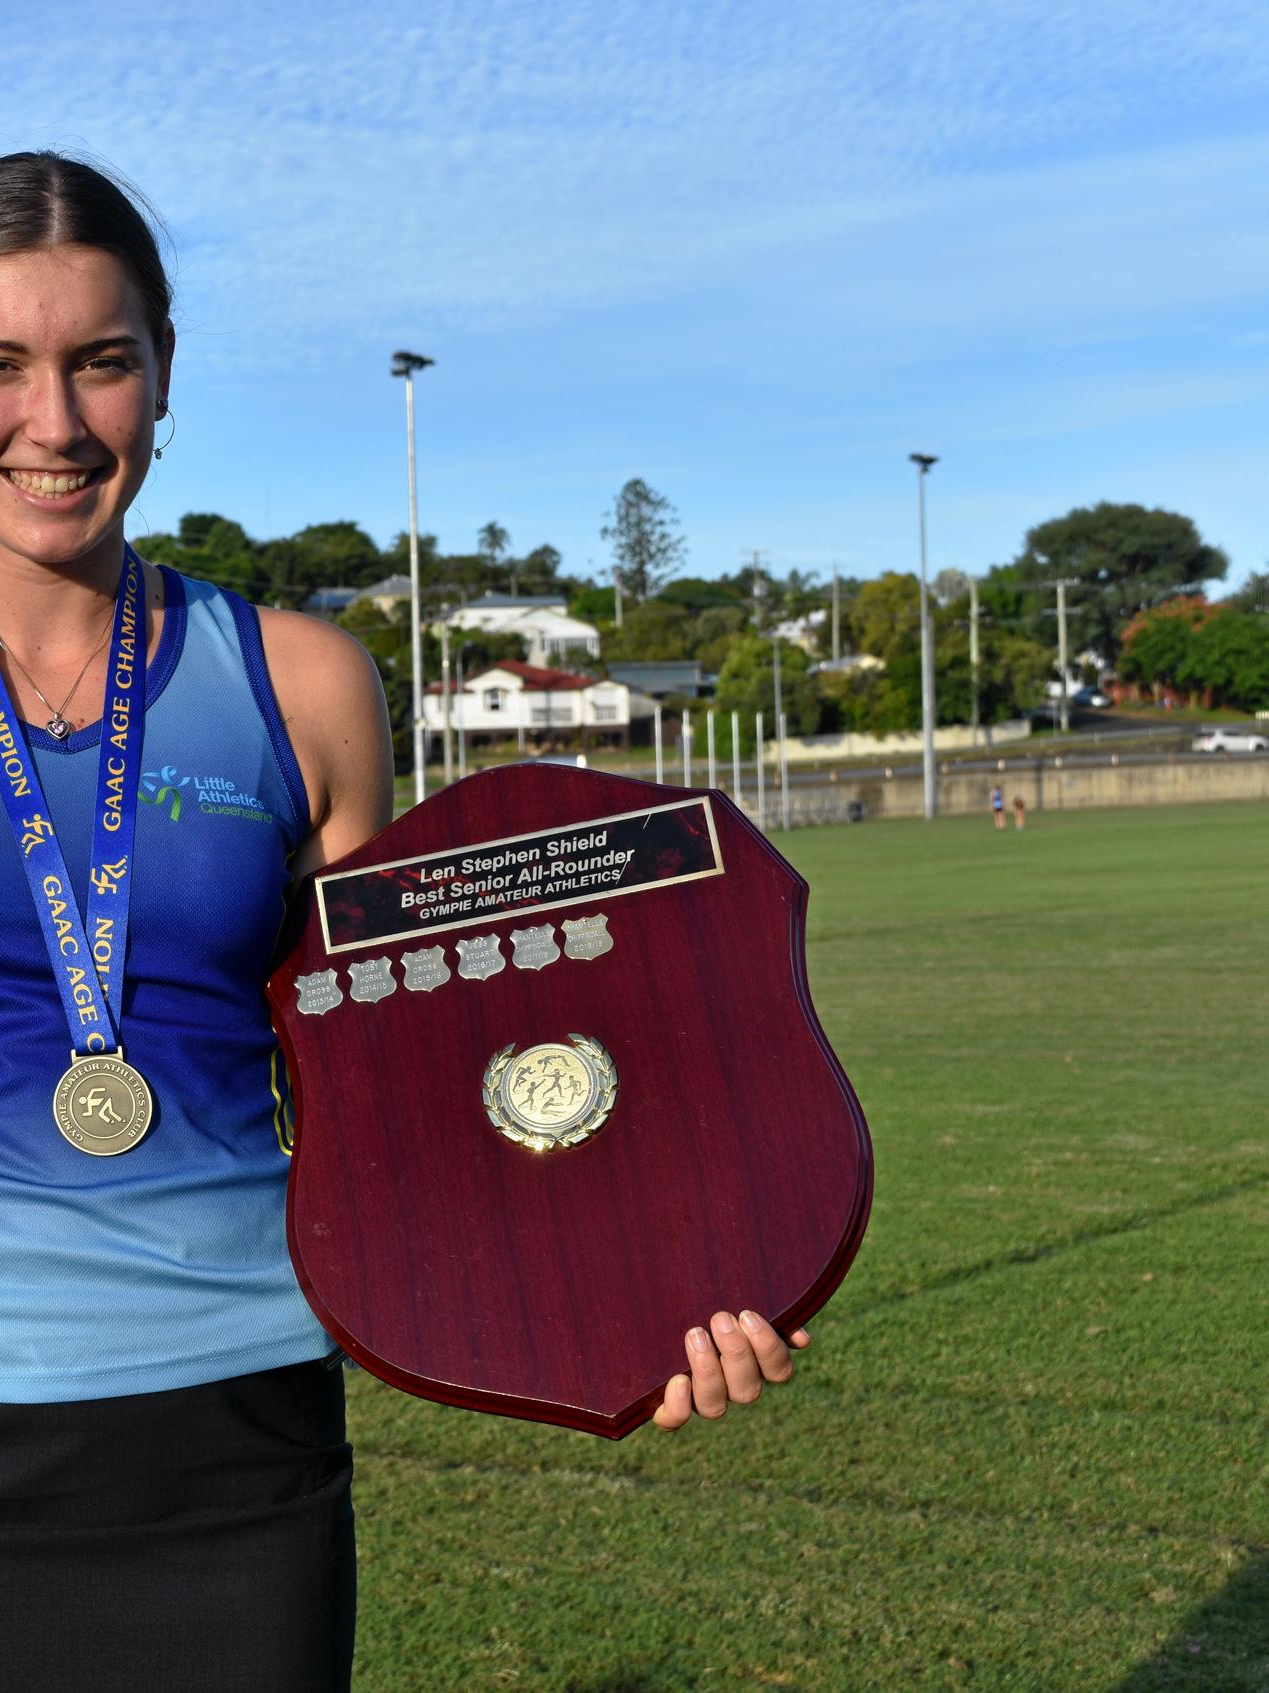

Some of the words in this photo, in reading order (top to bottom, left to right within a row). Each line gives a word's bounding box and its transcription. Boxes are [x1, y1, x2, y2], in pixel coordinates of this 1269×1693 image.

[115, 556, 138, 690] CHAMPION
[110, 697, 130, 750] AGE
[102, 758, 126, 831] GAAC
[194, 776, 235, 791] Little
[198, 790, 265, 810] Athletics
[200, 802, 273, 824] Queensland
[420, 865, 456, 884] Len
[461, 847, 541, 876] Stephen
[546, 831, 608, 857] Shield
[401, 886, 445, 909] Best
[450, 872, 515, 899] Senior
[517, 847, 635, 885] All-Rounder
[419, 897, 473, 919] GYMPIE
[475, 885, 542, 908] AMATEUR
[544, 868, 621, 895] ATHLETICS
[43, 875, 78, 956] GAAC
[66, 966, 98, 1025] AGE
[415, 953, 433, 963] ADAM
[466, 949, 493, 961] STUART
[359, 973, 383, 983] HORNE
[413, 963, 437, 974] CROSS
[467, 959, 496, 971] 2016/17
[307, 976, 328, 986] ADAM
[307, 986, 331, 997] CROSS
[60, 1063, 100, 1100] AMATEUR
[103, 1063, 146, 1107] ATHLETICS
[60, 1103, 83, 1142] GYMPIE
[128, 1110, 146, 1138] CLUB
